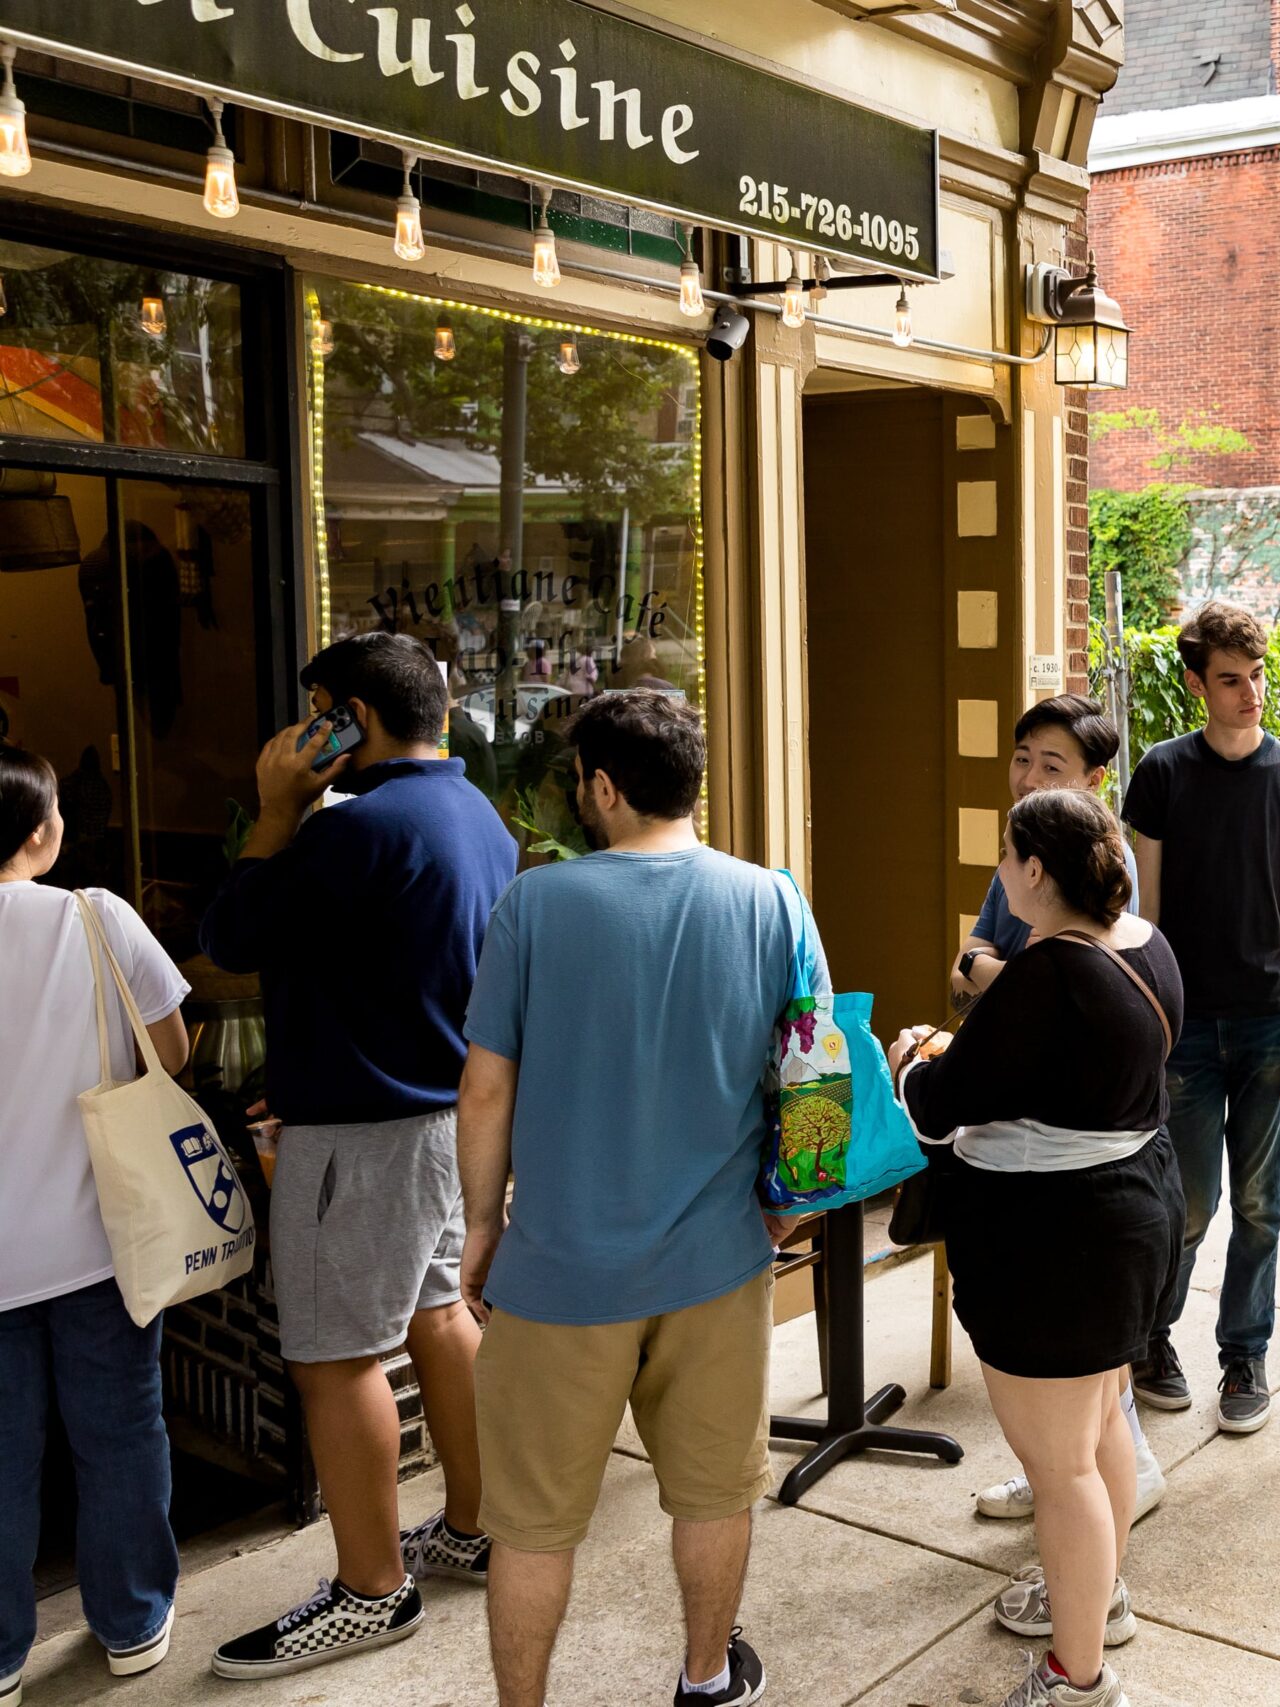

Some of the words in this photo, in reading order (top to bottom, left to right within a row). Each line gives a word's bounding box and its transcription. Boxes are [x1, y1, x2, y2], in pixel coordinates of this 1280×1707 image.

[286, 0, 700, 165] Cuisine
[739, 174, 920, 261] 215-726-1095
[366, 557, 577, 634] Vientiane
[592, 574, 668, 644] Café
[184, 1245, 218, 1275] PENN
